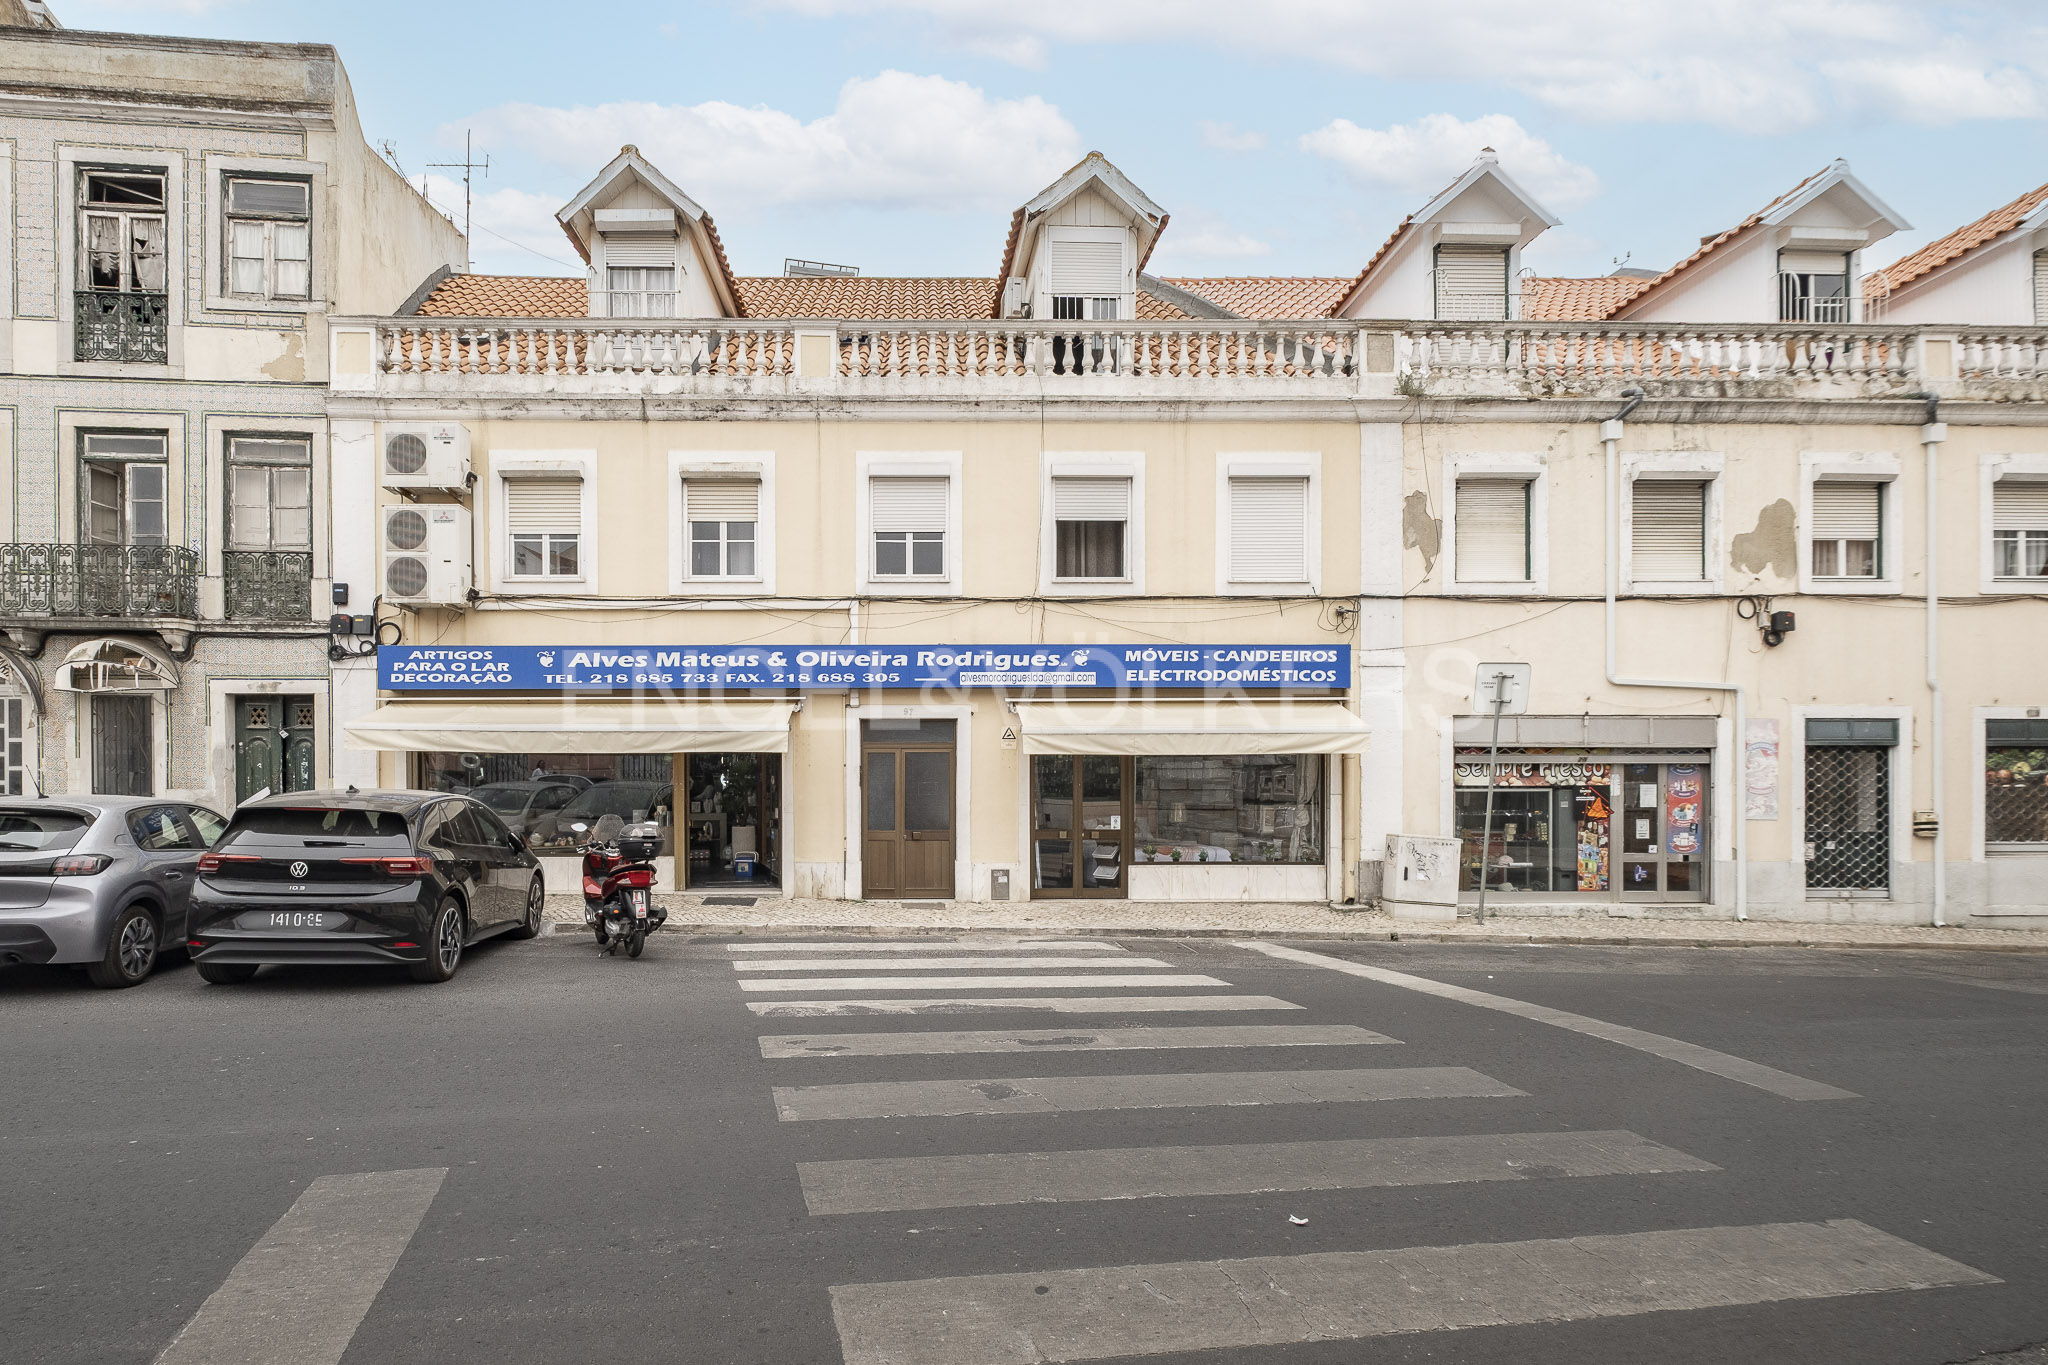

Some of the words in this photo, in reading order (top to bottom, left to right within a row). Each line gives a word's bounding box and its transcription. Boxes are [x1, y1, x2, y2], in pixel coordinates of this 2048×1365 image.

[408, 650, 493, 660] ARTIGOS
[568, 652, 648, 668] Alves
[656, 651, 759, 668] Mateus
[767, 651, 788, 667] &
[795, 651, 908, 667] Oliveira
[916, 651, 1060, 671] Rodrigues
[1125, 648, 1199, 662] MÓVEIS
[1213, 650, 1338, 662] CANDEEIROS
[393, 662, 447, 672] PARA
[450, 662, 467, 672] O
[470, 662, 510, 672] LAR
[390, 671, 513, 685] DECORAÇÃO
[543, 674, 583, 684] TEL.
[590, 673, 629, 684] 218
[635, 673, 674, 684] 685
[680, 673, 719, 684] 733
[726, 673, 765, 683] FAX.
[772, 673, 811, 683] 218
[817, 673, 856, 683] 688
[862, 673, 900, 683] 305
[1126, 668, 1337, 682] ELECTRODOMÉSTICOS
